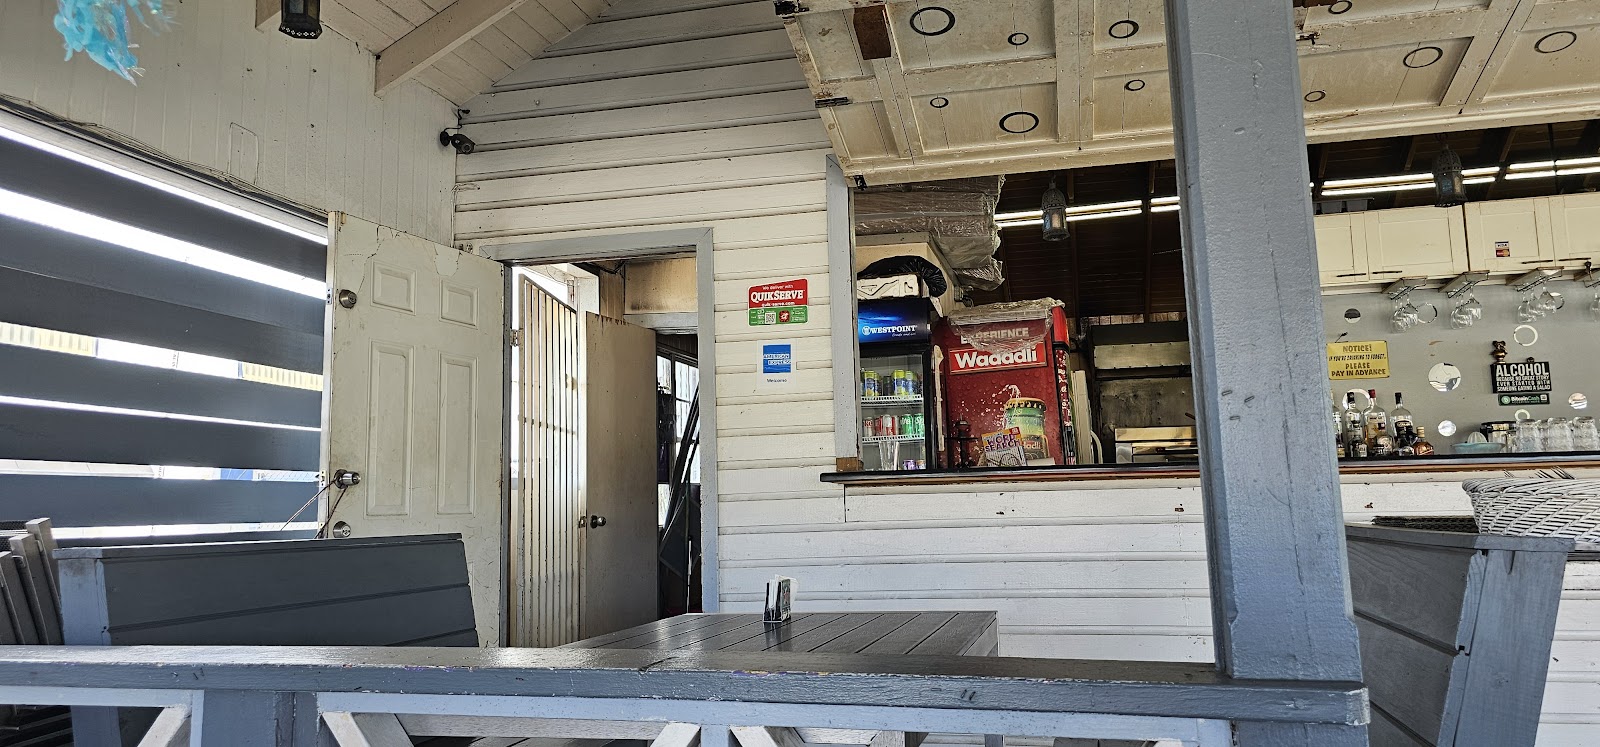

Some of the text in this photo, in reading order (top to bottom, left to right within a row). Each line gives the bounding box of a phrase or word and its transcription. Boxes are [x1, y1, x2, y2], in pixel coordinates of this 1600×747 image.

[750, 289, 804, 303] QUIKSERVE
[870, 325, 917, 334] WESTPOINT
[1343, 343, 1373, 352] NOTICE!
[1355, 368, 1386, 376] ADVANCE
[1496, 362, 1550, 377] ALCOHOL
[985, 439, 1021, 451] SEARCH
[986, 433, 1015, 445] WORD
